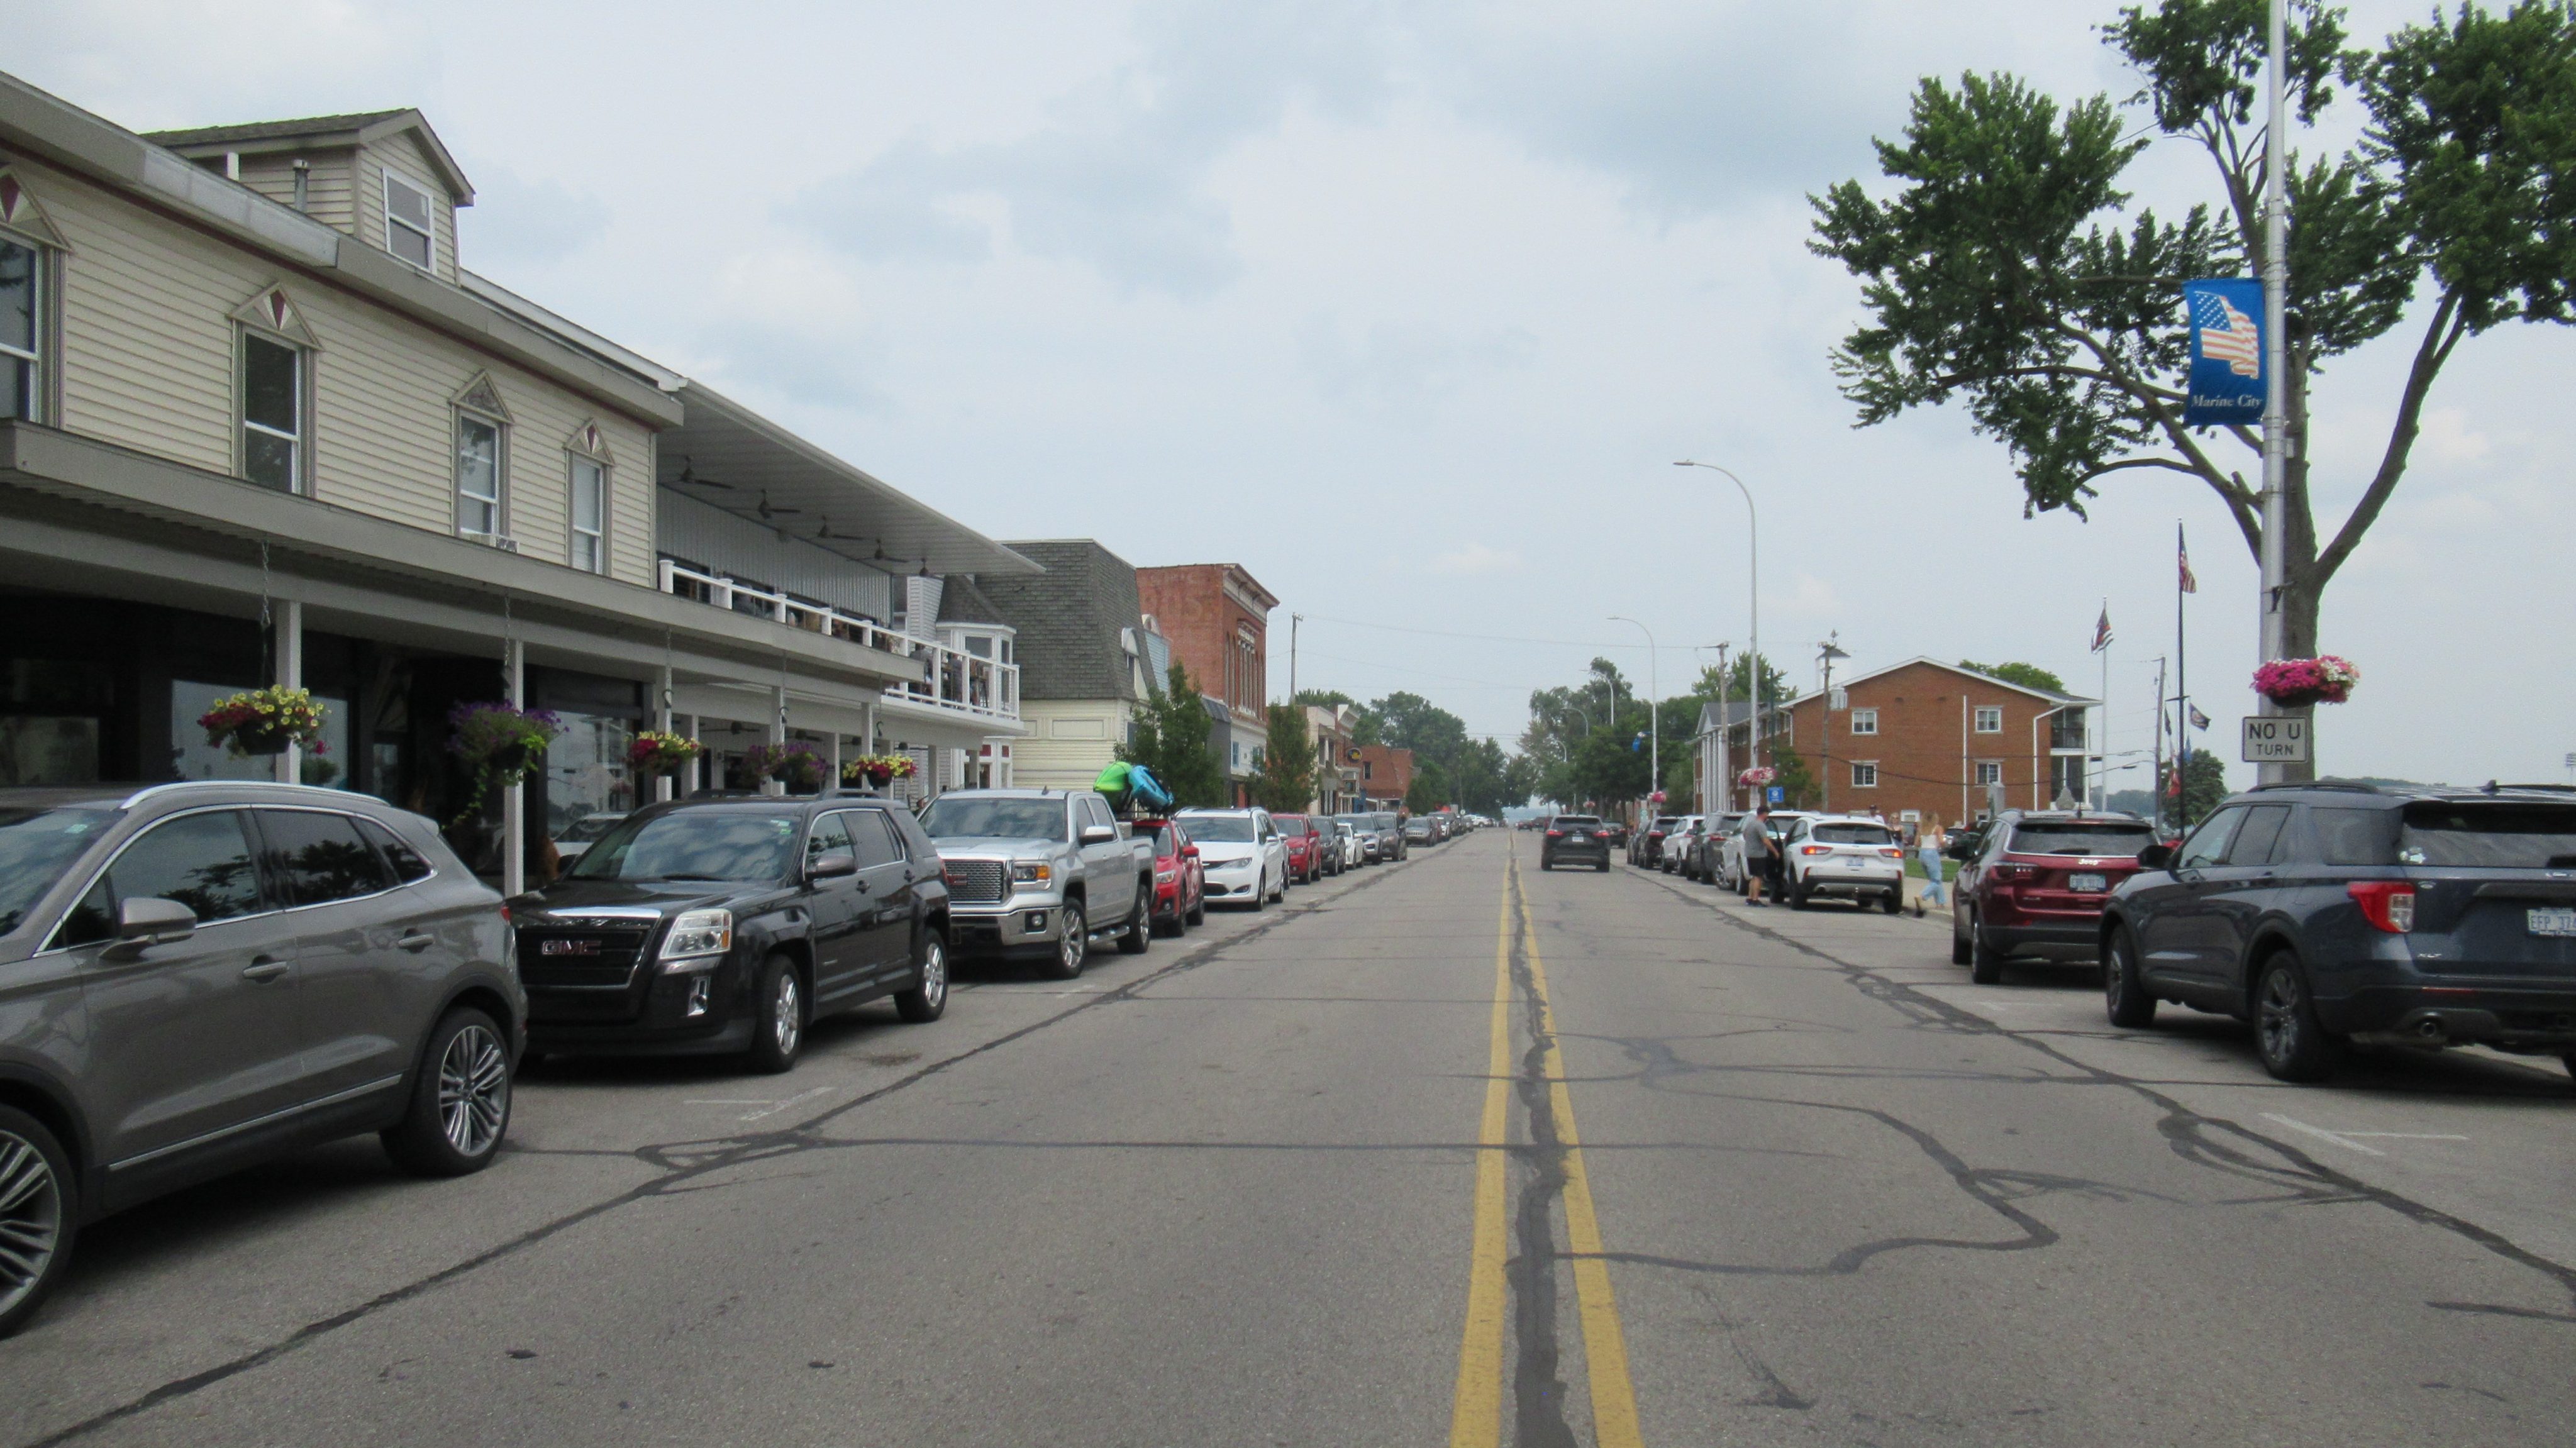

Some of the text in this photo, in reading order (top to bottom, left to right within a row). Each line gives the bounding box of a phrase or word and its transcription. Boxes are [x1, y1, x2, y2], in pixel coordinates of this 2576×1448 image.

[2191, 394, 2262, 409] Marine City
[2250, 723, 2301, 739] NO U
[2257, 744, 2294, 755] TURN
[2078, 858, 2099, 866] Jeep
[542, 940, 601, 955] GMC
